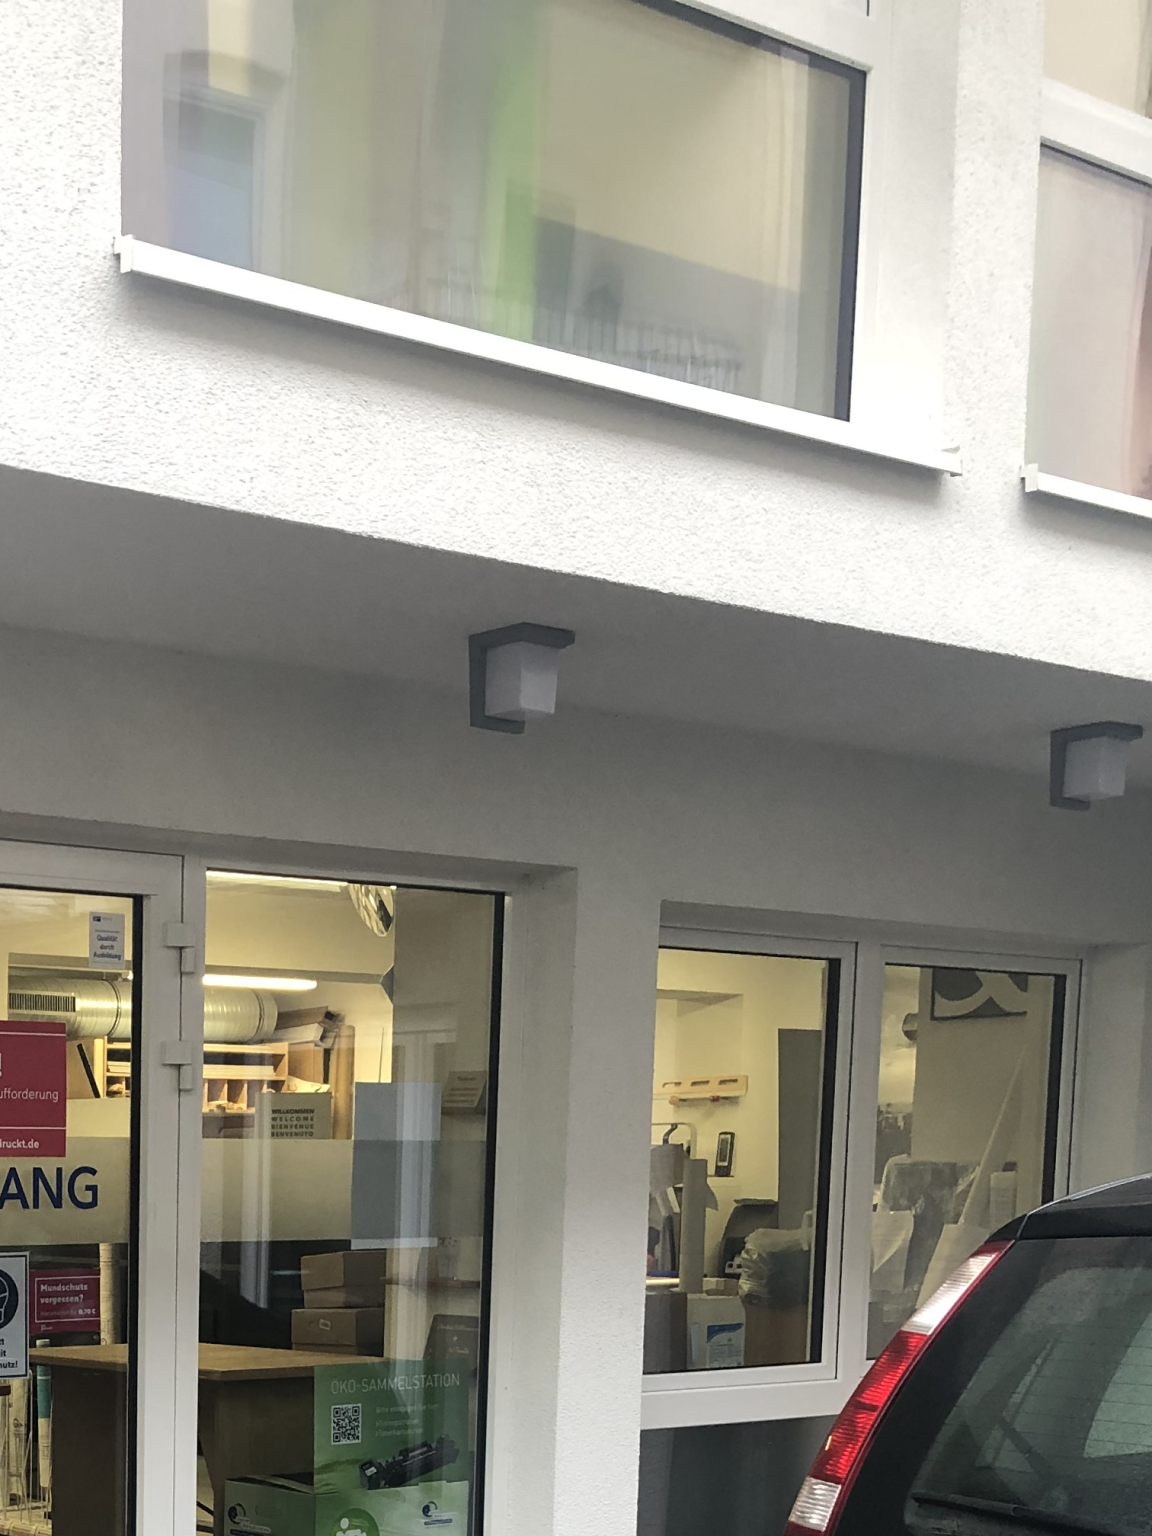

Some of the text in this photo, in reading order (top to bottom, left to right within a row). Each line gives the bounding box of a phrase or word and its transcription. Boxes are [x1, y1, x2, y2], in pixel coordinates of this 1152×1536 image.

[40, 1283, 89, 1292] Mundschutz
[40, 1294, 84, 1305] vergessen?
[330, 1373, 461, 1394] ÖKO-SAMMELSTATION
